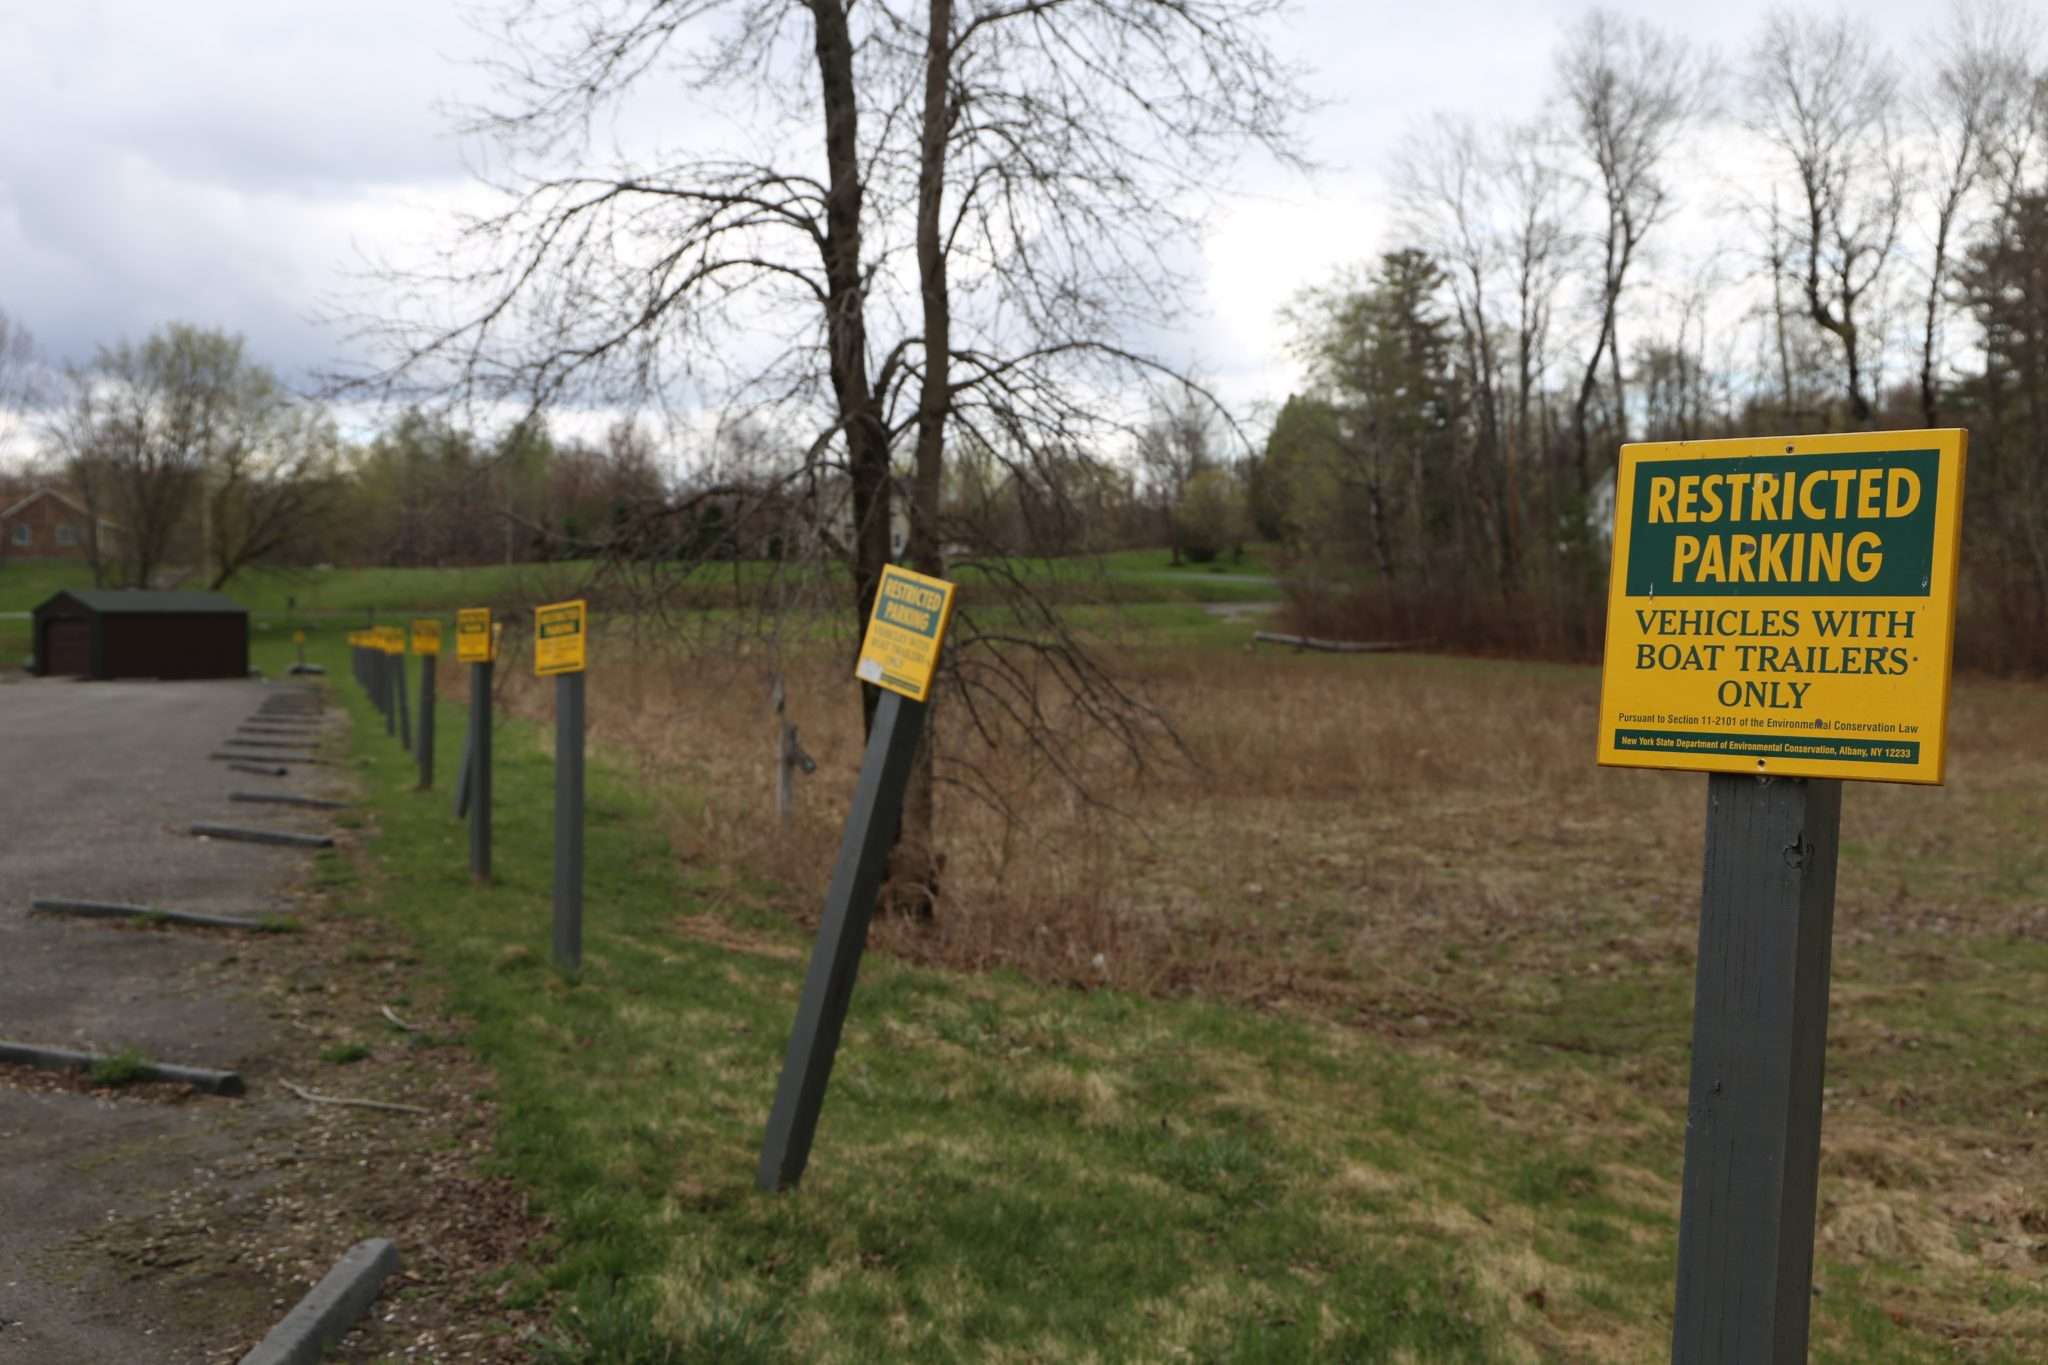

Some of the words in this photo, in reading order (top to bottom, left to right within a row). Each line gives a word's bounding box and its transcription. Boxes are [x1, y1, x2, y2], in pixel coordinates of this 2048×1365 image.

[1648, 467, 1921, 524] RESTRICTED
[1672, 531, 1884, 583] PARKING
[1635, 610, 1800, 637] VEHICLES
[1812, 610, 1916, 638] WITH
[1635, 643, 1725, 672] BOAT
[1735, 645, 1909, 675] TRAILERS
[1718, 679, 1812, 709] ONLY
[1619, 712, 1655, 724] Pursuant
[1657, 714, 1665, 724] to
[1667, 714, 1699, 725] Section
[1702, 716, 1736, 727] 11-2101
[1739, 717, 1749, 727] of
[1750, 717, 1764, 728] the
[1834, 720, 1895, 732] Conservation
[1898, 723, 1919, 734] Law
[1622, 735, 1637, 745] New
[1639, 736, 1654, 746] York
[1655, 737, 1674, 747] State
[1676, 738, 1720, 750] Department
[1720, 740, 1728, 749] of
[1730, 741, 1782, 752] Environmental
[1785, 743, 1837, 755] Conservation,
[1839, 745, 1868, 758] Albany,
[1870, 747, 1885, 757] NY
[1886, 748, 1911, 758] 12233
